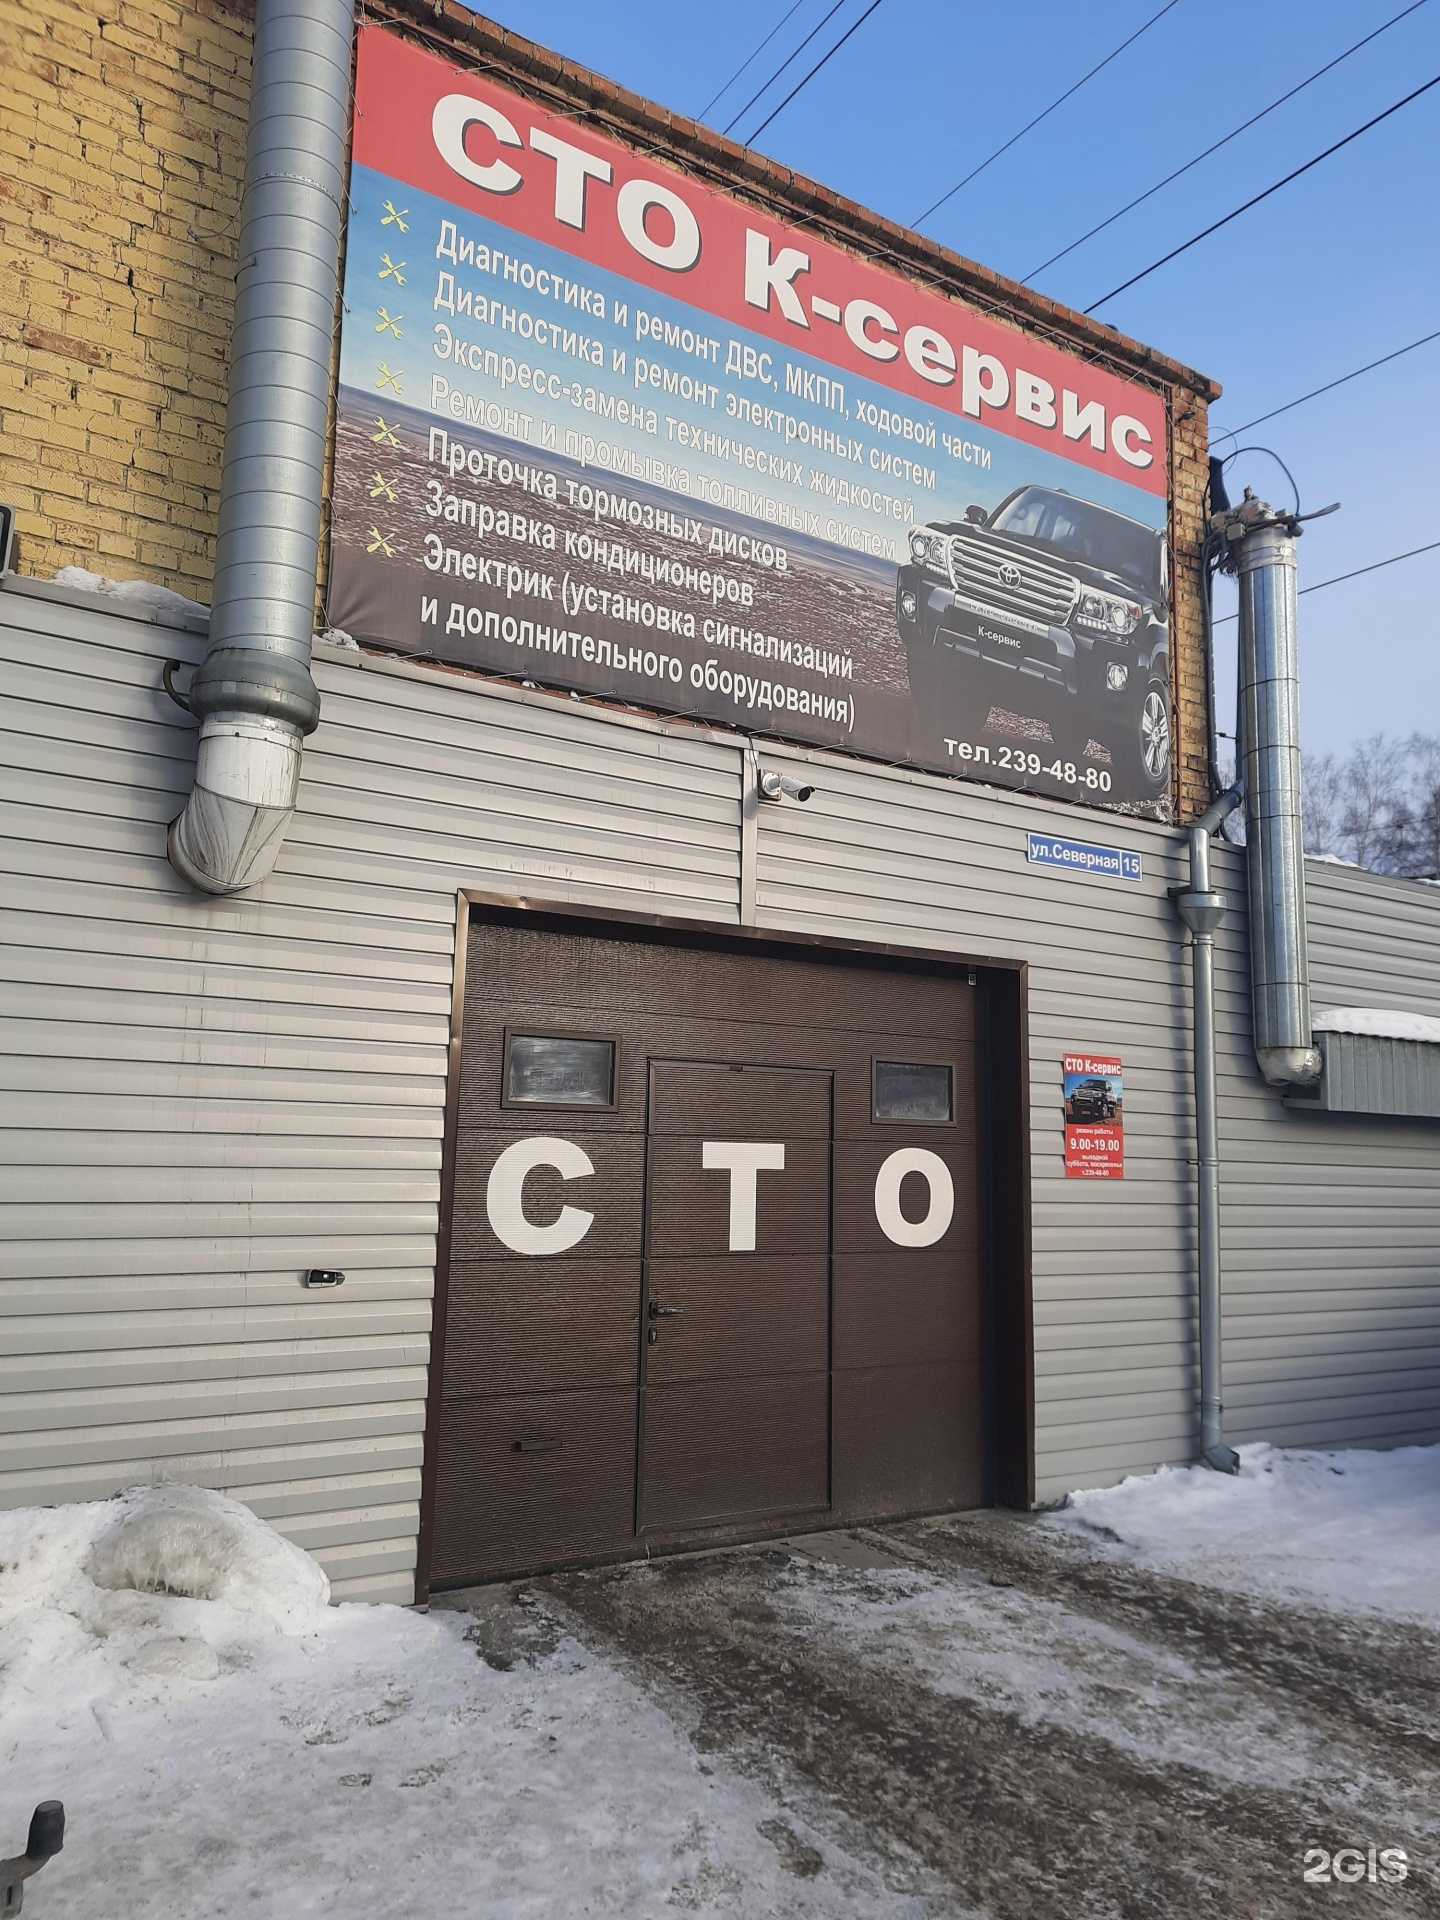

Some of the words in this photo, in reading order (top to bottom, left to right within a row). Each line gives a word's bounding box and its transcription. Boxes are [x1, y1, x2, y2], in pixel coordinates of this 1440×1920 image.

[432, 93, 702, 272] СТО
[744, 227, 1154, 469] К-сервис
[436, 219, 606, 319] Диагностика
[613, 301, 628, 327] и
[636, 309, 721, 363] ремонт
[725, 339, 779, 393] ДВС,
[785, 362, 850, 421] МКПП,
[856, 395, 937, 449] ходовой
[942, 436, 992, 471] части
[432, 323, 658, 436] Экспресс-замена
[665, 415, 803, 487] технических
[809, 468, 915, 525] жидкостей
[433, 270, 604, 366] Диагностика
[612, 349, 626, 375] и
[634, 356, 720, 409] ремонт
[725, 392, 863, 464] электронных
[869, 448, 936, 491] систем
[428, 426, 558, 500] Проточка
[565, 479, 703, 546] тормозных
[708, 527, 788, 572] дисков
[430, 374, 534, 441] Ремонт
[540, 420, 556, 450] и
[564, 428, 692, 493] промывка
[697, 474, 820, 538] топливных
[826, 518, 897, 563] систем
[423, 533, 555, 601] Электрик
[562, 570, 696, 639] (установка
[702, 617, 854, 681] сигнализаций
[425, 479, 557, 551] Заправка
[564, 530, 755, 608] кондиционеров
[420, 595, 439, 625] и
[445, 601, 683, 684] дополнительного
[689, 659, 856, 734] оборудования)
[977, 624, 1022, 649] К-сервис
[943, 737, 1113, 793] тел.239-48-80
[1031, 843, 1119, 870] ул.Северная
[1123, 857, 1140, 873] 15
[1065, 1057, 1083, 1072] СТО
[1085, 1060, 1122, 1076] К-сервис
[1070, 1137, 1120, 1152] 9.00-19.00
